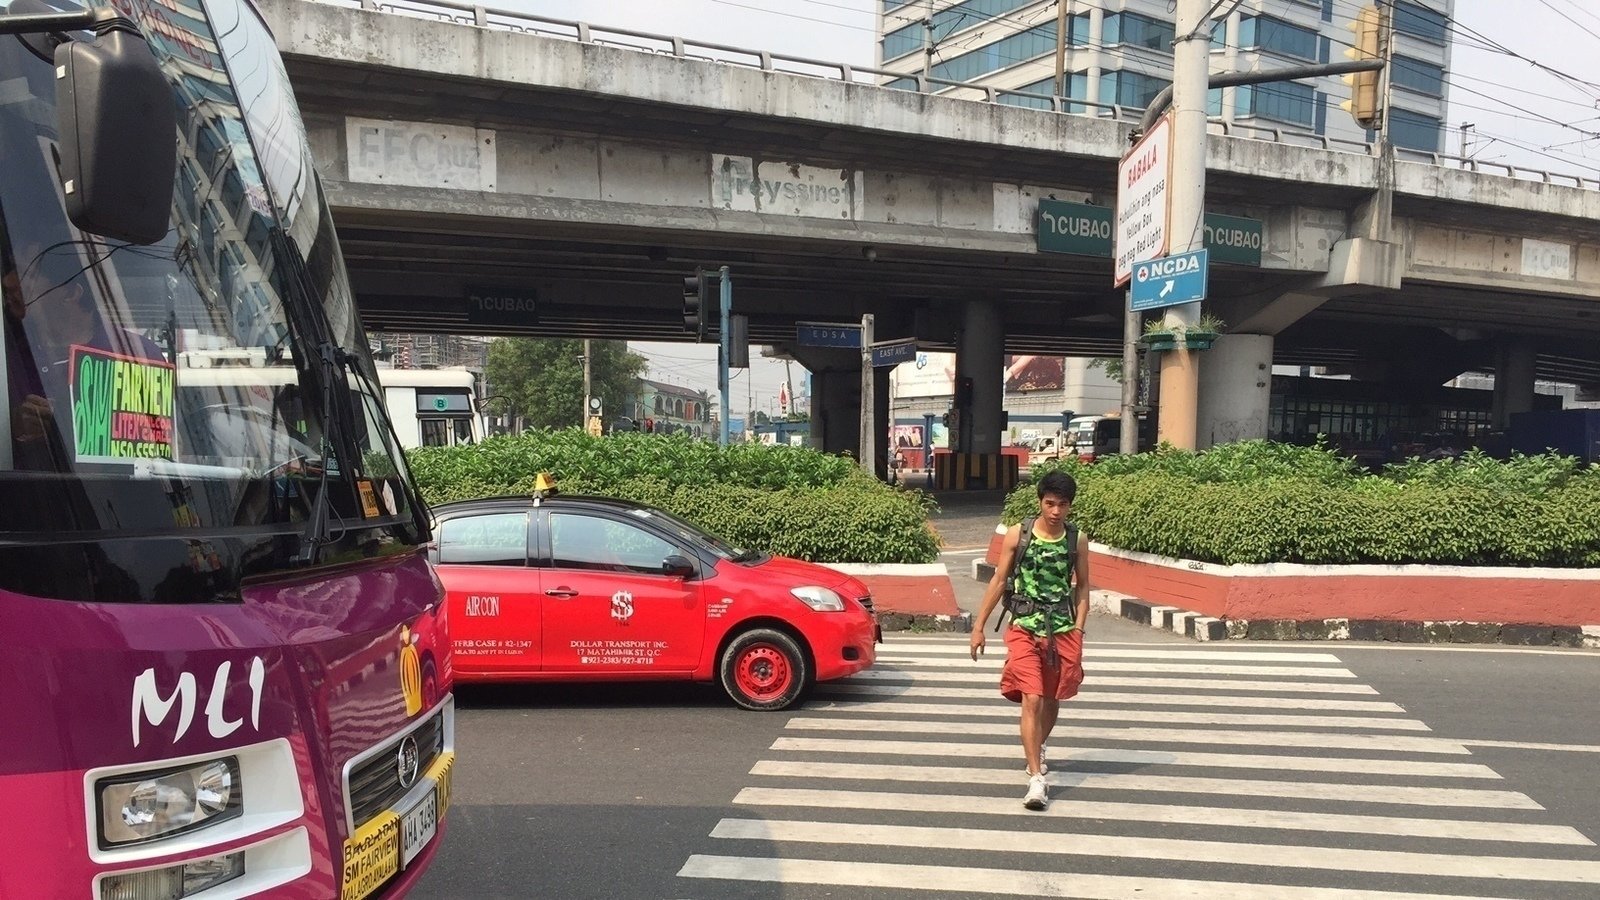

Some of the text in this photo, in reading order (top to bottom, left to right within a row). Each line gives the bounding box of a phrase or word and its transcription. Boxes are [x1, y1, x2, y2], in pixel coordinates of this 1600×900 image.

[1127, 144, 1157, 189] BABALA
[1141, 191, 1151, 208] ang
[1152, 179, 1165, 198] nasa
[1057, 216, 1111, 239] CUBAO
[1126, 211, 1152, 240] Yellow Box
[1215, 229, 1261, 250] CUBAO
[1118, 226, 1162, 268] pag nag Red Light
[1150, 255, 1200, 277] NCDA
[484, 296, 535, 311] CUBAO
[879, 348, 895, 358] EAST
[113, 360, 174, 417] FAIRVIEW
[75, 355, 114, 456] SM
[111, 411, 141, 440] LITEX
[465, 596, 500, 616] AIR CON
[570, 640, 603, 648] DOLLAR
[605, 640, 652, 648] TRANSPORT
[131, 656, 265, 748] MLI
[404, 817, 418, 851] AHA
[345, 861, 359, 884] SM
[360, 833, 398, 875] FAIRVIEW
